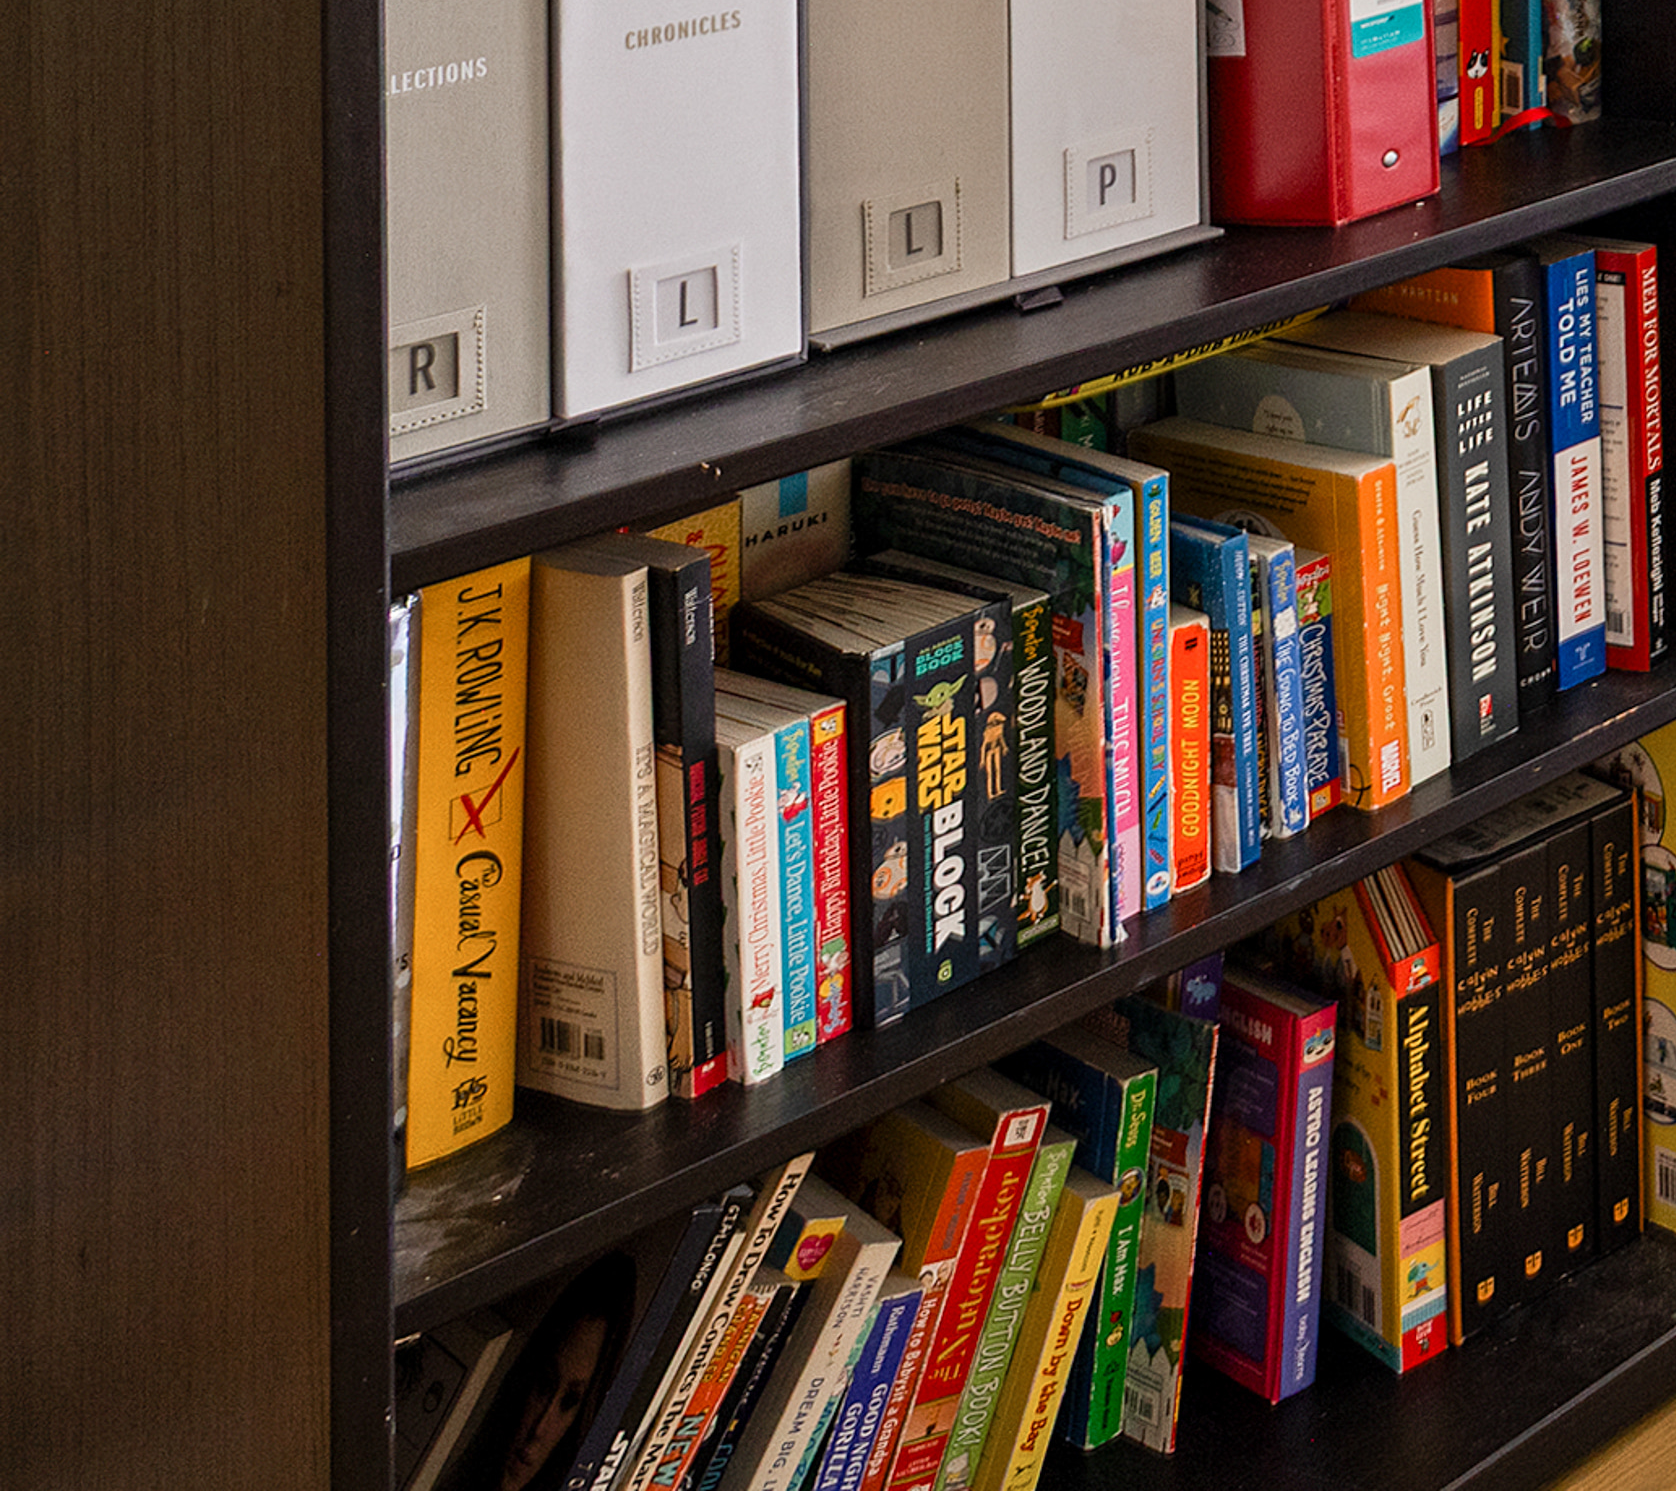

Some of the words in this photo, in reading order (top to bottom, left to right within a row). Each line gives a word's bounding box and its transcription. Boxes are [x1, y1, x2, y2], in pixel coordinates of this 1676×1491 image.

[625, 10, 742, 50] CHRONICLES
[1575, 268, 1589, 307] LIES
[1641, 265, 1657, 317] MEB
[1558, 297, 1576, 364] TOLD
[1579, 312, 1592, 339] MY
[1643, 317, 1659, 365] FOR
[1510, 297, 1540, 442] ARTEMIS
[1559, 370, 1577, 408] ME
[1580, 344, 1594, 424] TEACHER
[1457, 390, 1493, 418] LIFE
[1458, 410, 1493, 436] AFTER
[1644, 365, 1662, 472] MORTALS
[1459, 427, 1494, 456] LIFE
[1464, 460, 1492, 536] KATE
[1570, 455, 1590, 516] JAMES
[745, 513, 828, 548] HARUKI
[1375, 582, 1391, 628] Night
[1466, 541, 1497, 685] ATKINSON
[1521, 560, 1548, 654] WEIR
[1572, 548, 1592, 624] LOEWEN
[915, 639, 964, 665] BLOCK
[915, 651, 964, 677] BOOK
[1301, 623, 1329, 719] CHRISTMAS
[1181, 679, 1200, 729] MOON
[1278, 669, 1294, 713] GOING
[1382, 684, 1397, 732] Groot
[1018, 655, 1050, 786] WOODLAND
[818, 740, 841, 796] Pookie
[917, 715, 942, 810] WARS
[942, 713, 967, 806] STAR
[1282, 736, 1299, 767] BED
[1304, 710, 1331, 790] PARADE
[1380, 738, 1401, 795] MARVEL
[745, 775, 766, 827] Pookie
[1181, 738, 1200, 838] GOODNIGHT
[1283, 769, 1300, 812] BOOK
[745, 829, 767, 867] Little
[784, 821, 806, 860] Let's
[1019, 784, 1050, 874] DANCE!
[456, 850, 503, 952] Casual
[934, 799, 966, 955] BLOCK
[786, 918, 808, 960] Little
[822, 886, 847, 942] Happy
[750, 941, 774, 993] Merry
[788, 962, 808, 1024] Pookie
[443, 939, 497, 1069] Vacancy
[1403, 1005, 1430, 1117] Alphabet
[1305, 1085, 1323, 1148] ASTRO
[1301, 1149, 1321, 1221] LEARNS
[1410, 1117, 1431, 1202] Street
[769, 1172, 802, 1221] How
[936, 1170, 1020, 1364] Nutcracker
[1008, 1206, 1050, 1275] BELLY
[1296, 1221, 1316, 1304] ENGLISH
[724, 1248, 761, 1310] Draw
[915, 1297, 938, 1329] How
[977, 1278, 1030, 1372] BUTTON
[1052, 1297, 1083, 1350] Down
[679, 1310, 732, 1394] Comics
[1042, 1352, 1067, 1378] by
[656, 1396, 688, 1439] The
[788, 1376, 825, 1436] DREAM
[859, 1382, 888, 1439] GOOD
[953, 1377, 999, 1450] BOOK!
[1035, 1382, 1058, 1415] the
[820, 1401, 864, 1489] GORILLA
[868, 1419, 899, 1478] Grandpa
[1020, 1417, 1048, 1454] Bay
